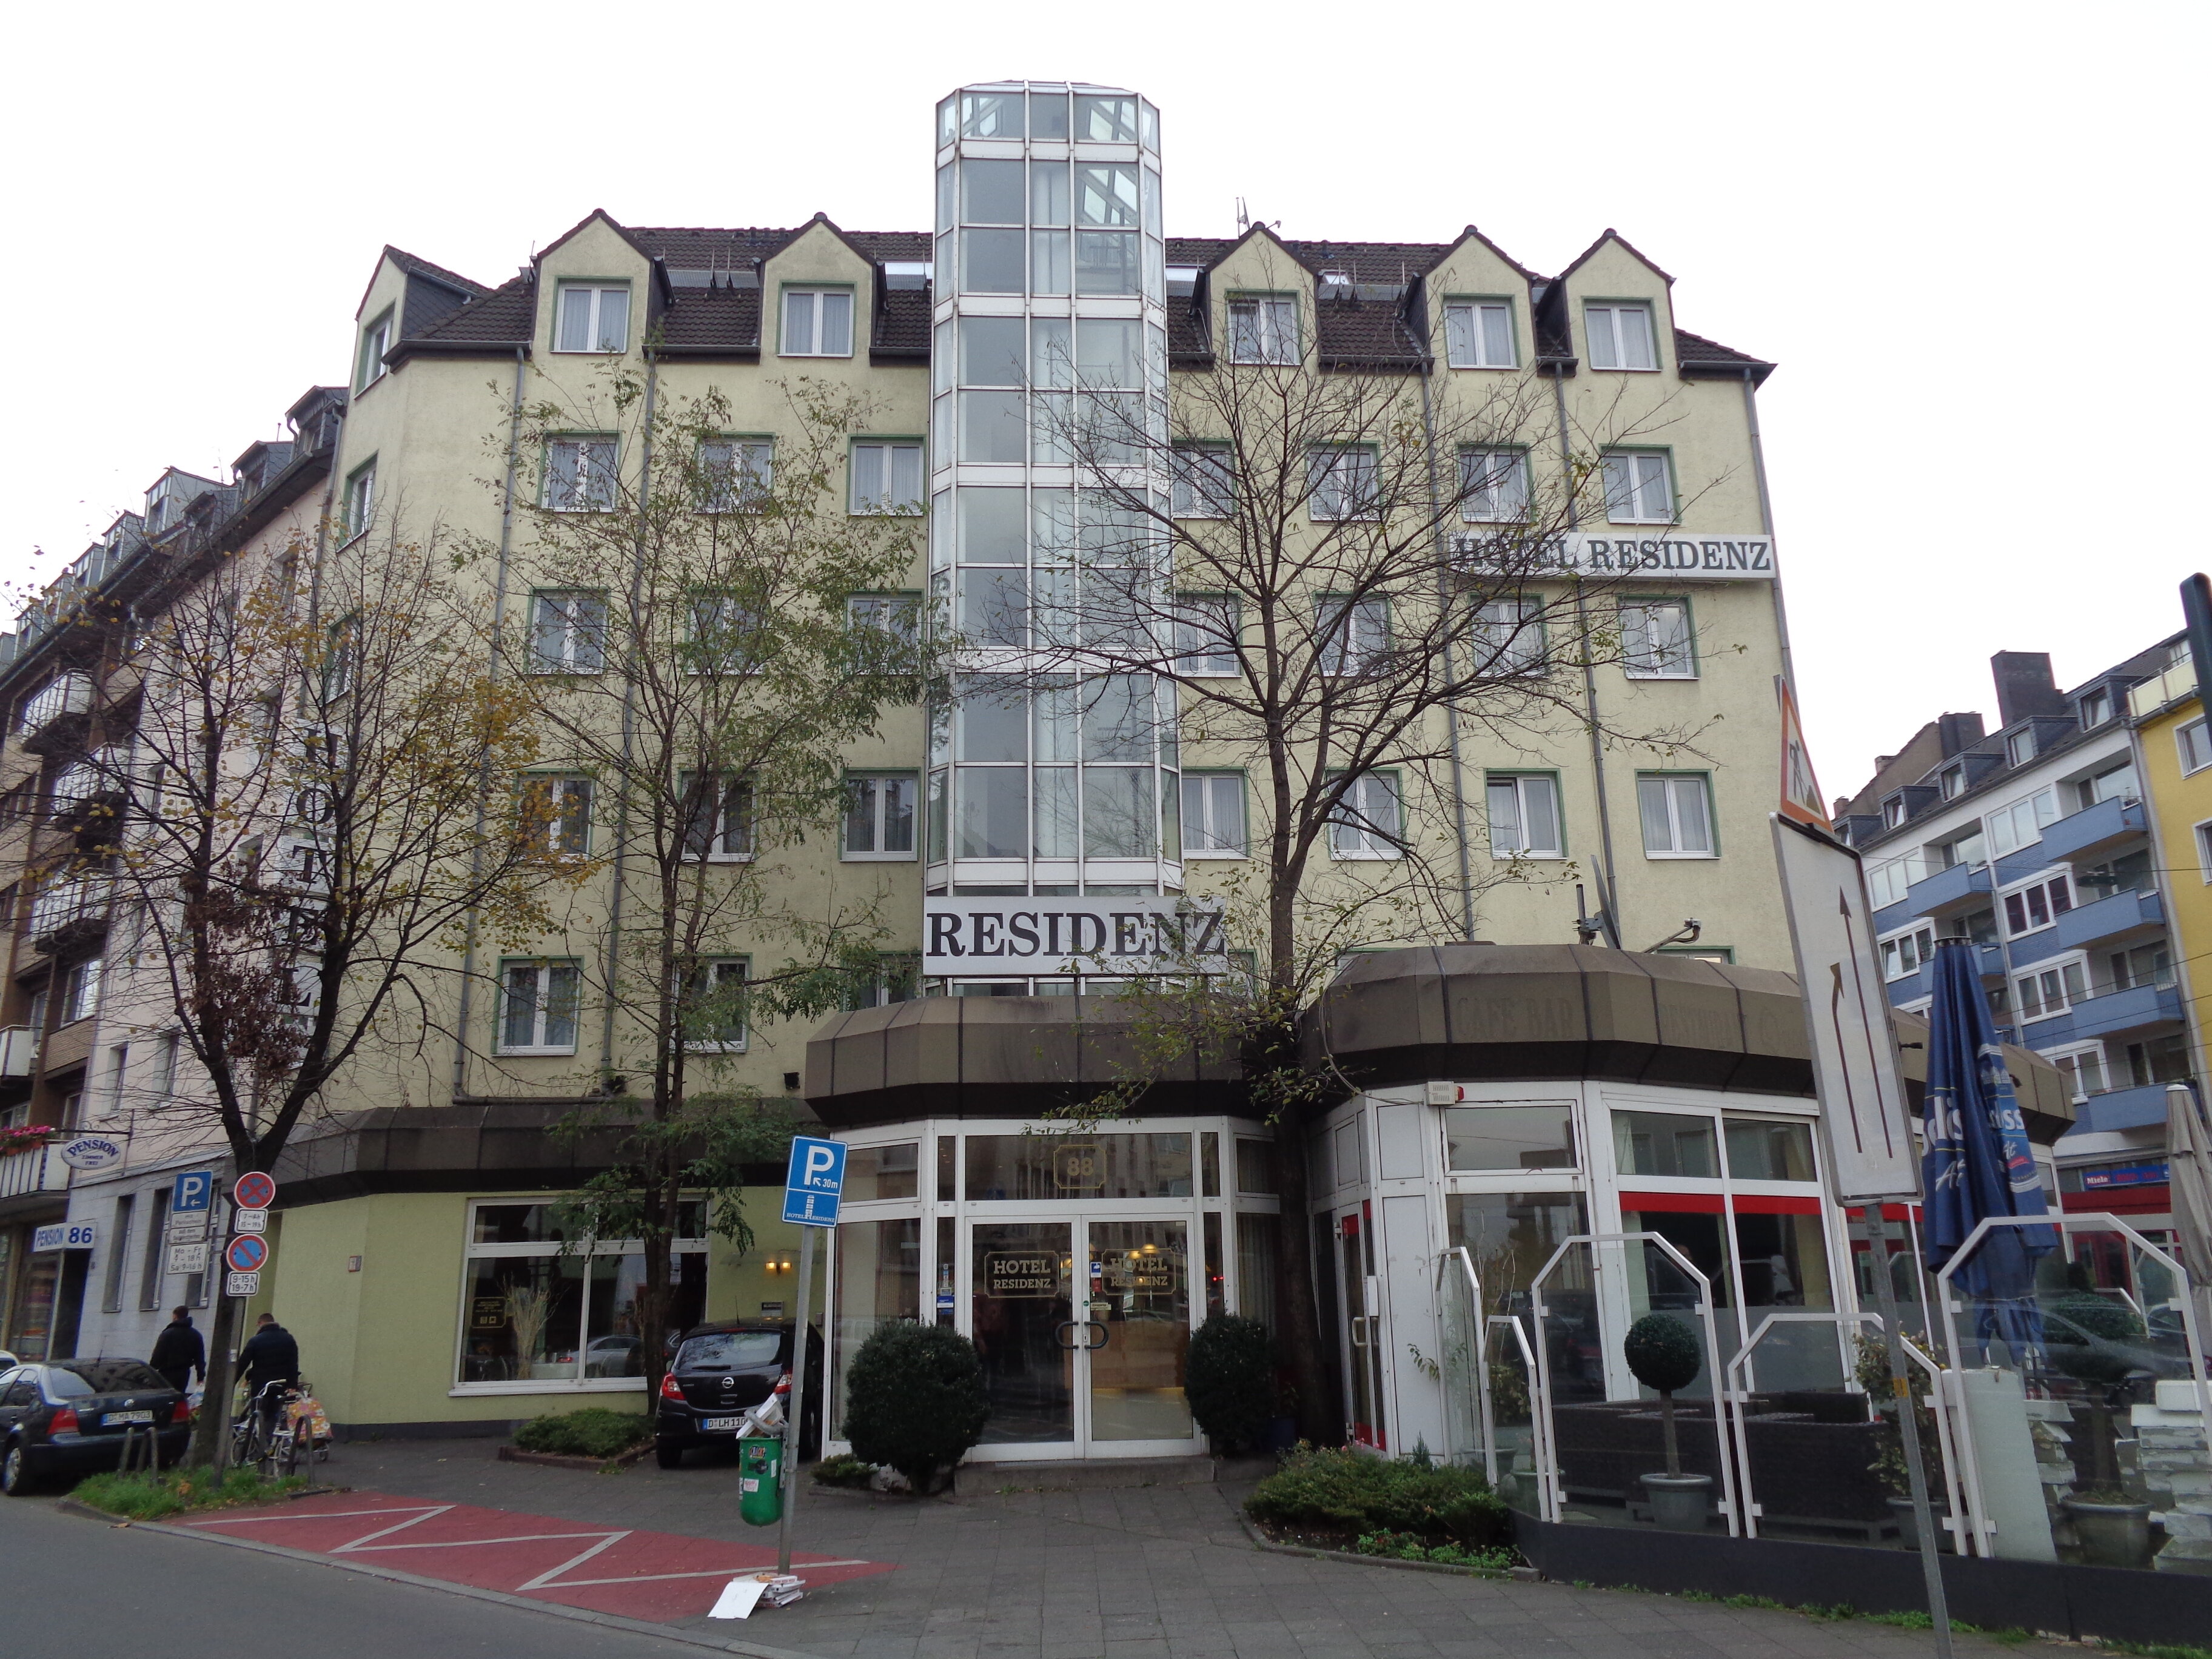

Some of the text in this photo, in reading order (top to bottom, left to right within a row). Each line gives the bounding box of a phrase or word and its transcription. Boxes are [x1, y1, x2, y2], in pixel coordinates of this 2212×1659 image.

[1587, 540, 1771, 571] RESIDENZ
[925, 912, 1225, 957] RESIDENZ
[67, 1139, 119, 1158] PENSION
[804, 1145, 834, 1185] P
[1067, 1158, 1093, 1176] 88
[181, 1177, 203, 1207] P
[38, 1227, 93, 1247] PENSION 86
[993, 1259, 1051, 1274] HOTEL
[1111, 1258, 1167, 1272] HOTEL
[993, 1278, 1051, 1289] RESIDENZ
[708, 1418, 748, 1428] D LH 110
